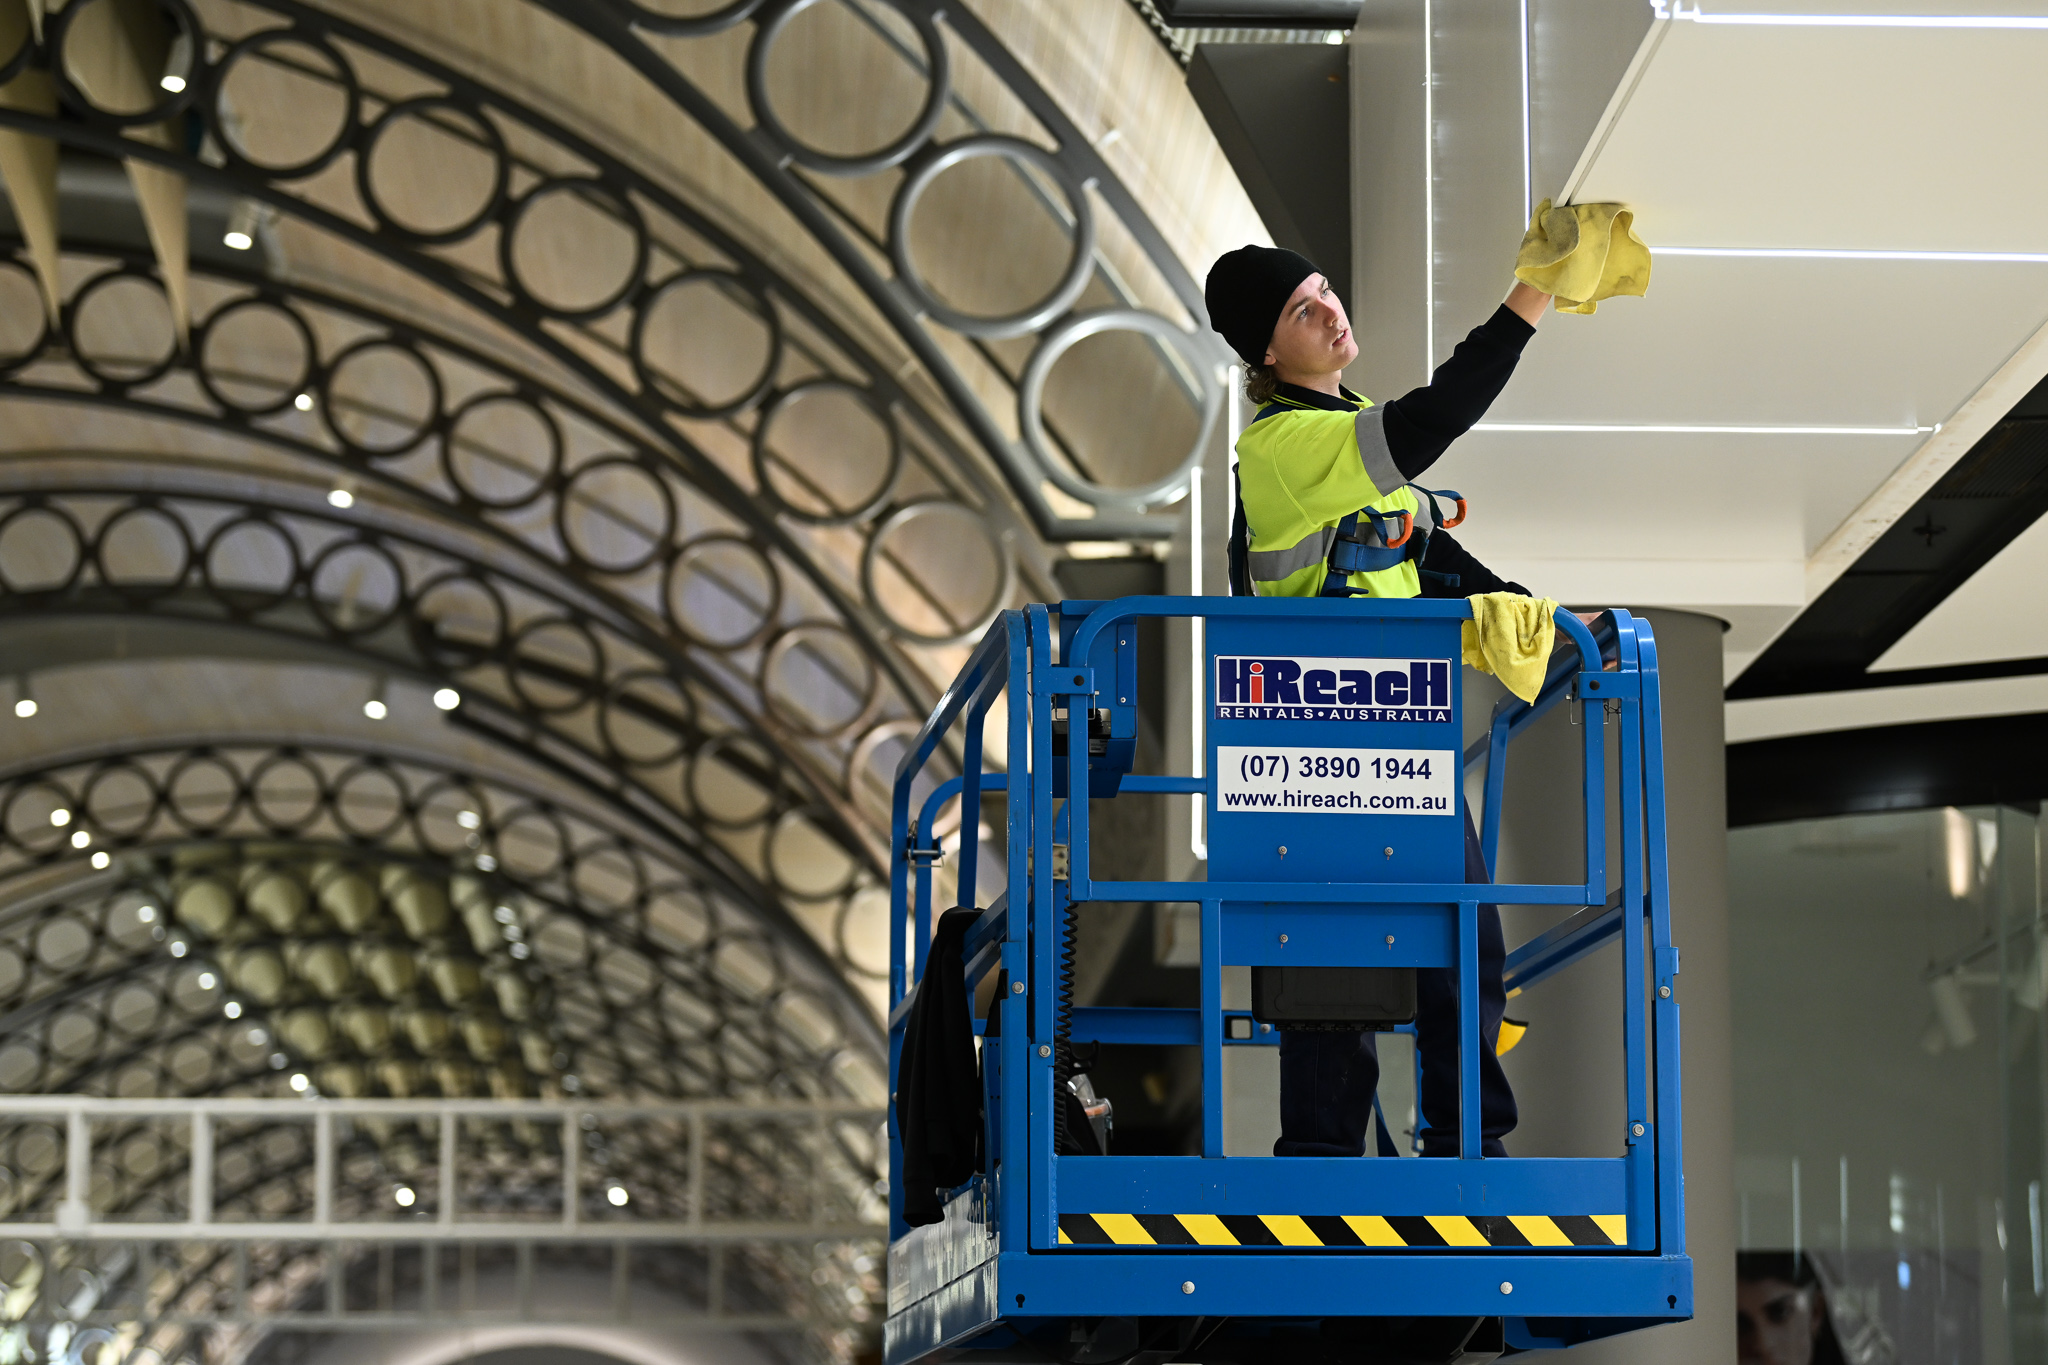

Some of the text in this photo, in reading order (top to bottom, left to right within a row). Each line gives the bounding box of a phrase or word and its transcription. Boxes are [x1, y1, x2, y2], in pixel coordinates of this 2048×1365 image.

[1220, 707, 1447, 722] RENTALS AUSTRALIA
[1240, 755, 1432, 782] (07) 3890 1944
[1225, 790, 1447, 810] www.hireach.com.au
